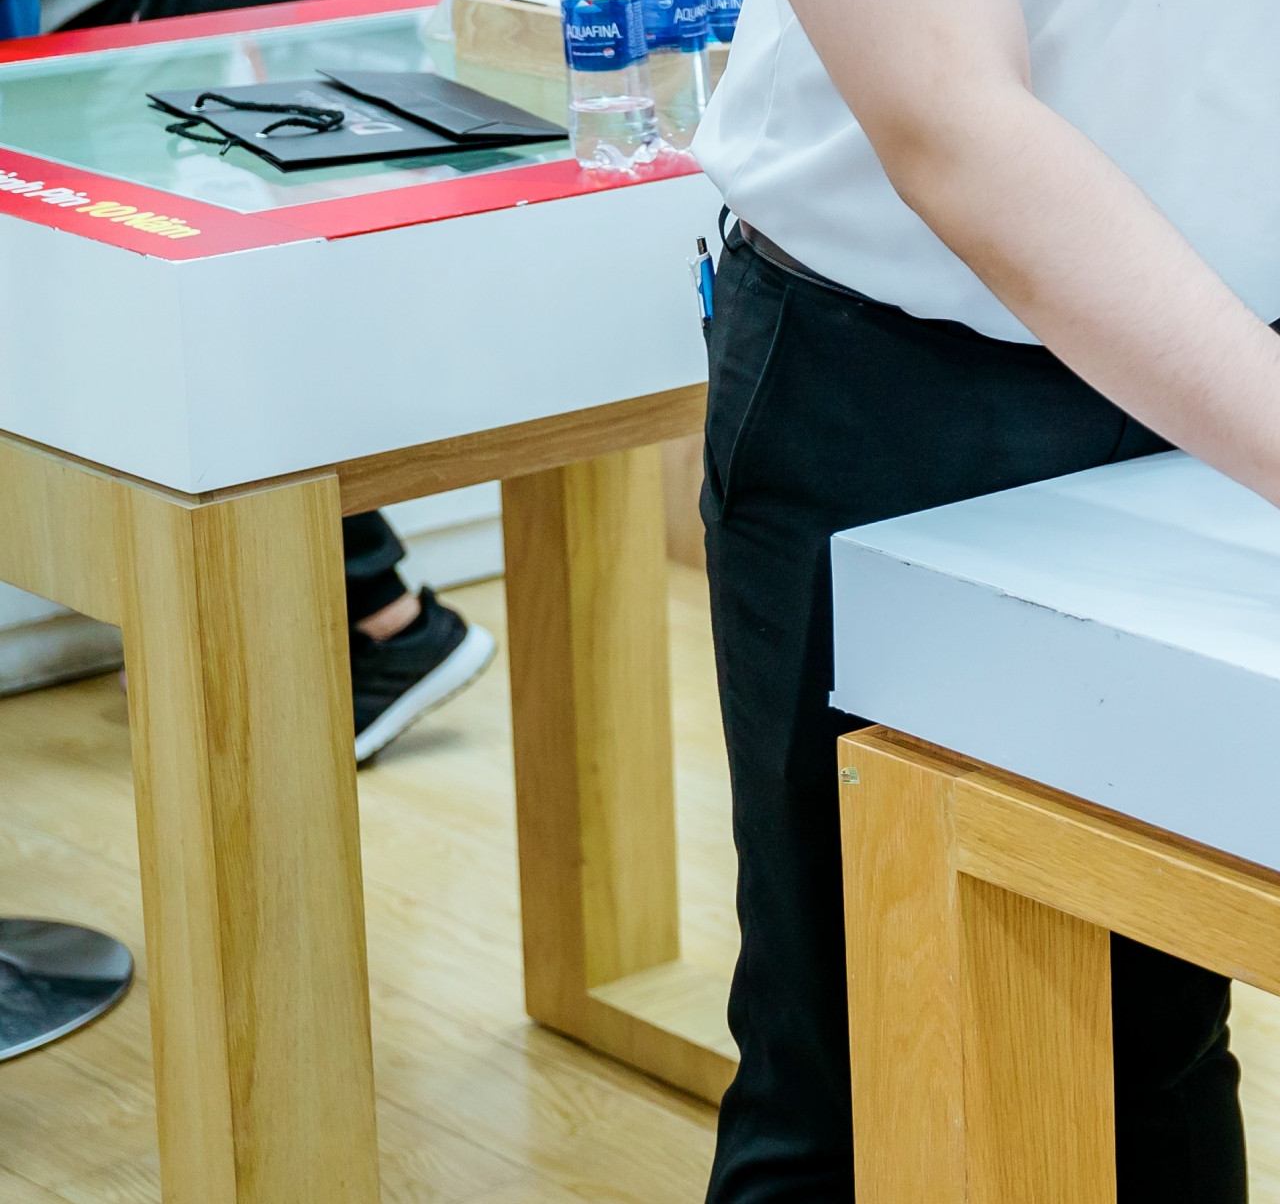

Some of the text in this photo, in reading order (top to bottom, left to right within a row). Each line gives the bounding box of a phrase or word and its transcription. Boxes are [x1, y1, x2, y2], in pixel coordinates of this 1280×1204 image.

[566, 22, 624, 41] AQUAFINA
[75, 201, 138, 217] 10
[110, 211, 201, 239] Năm
